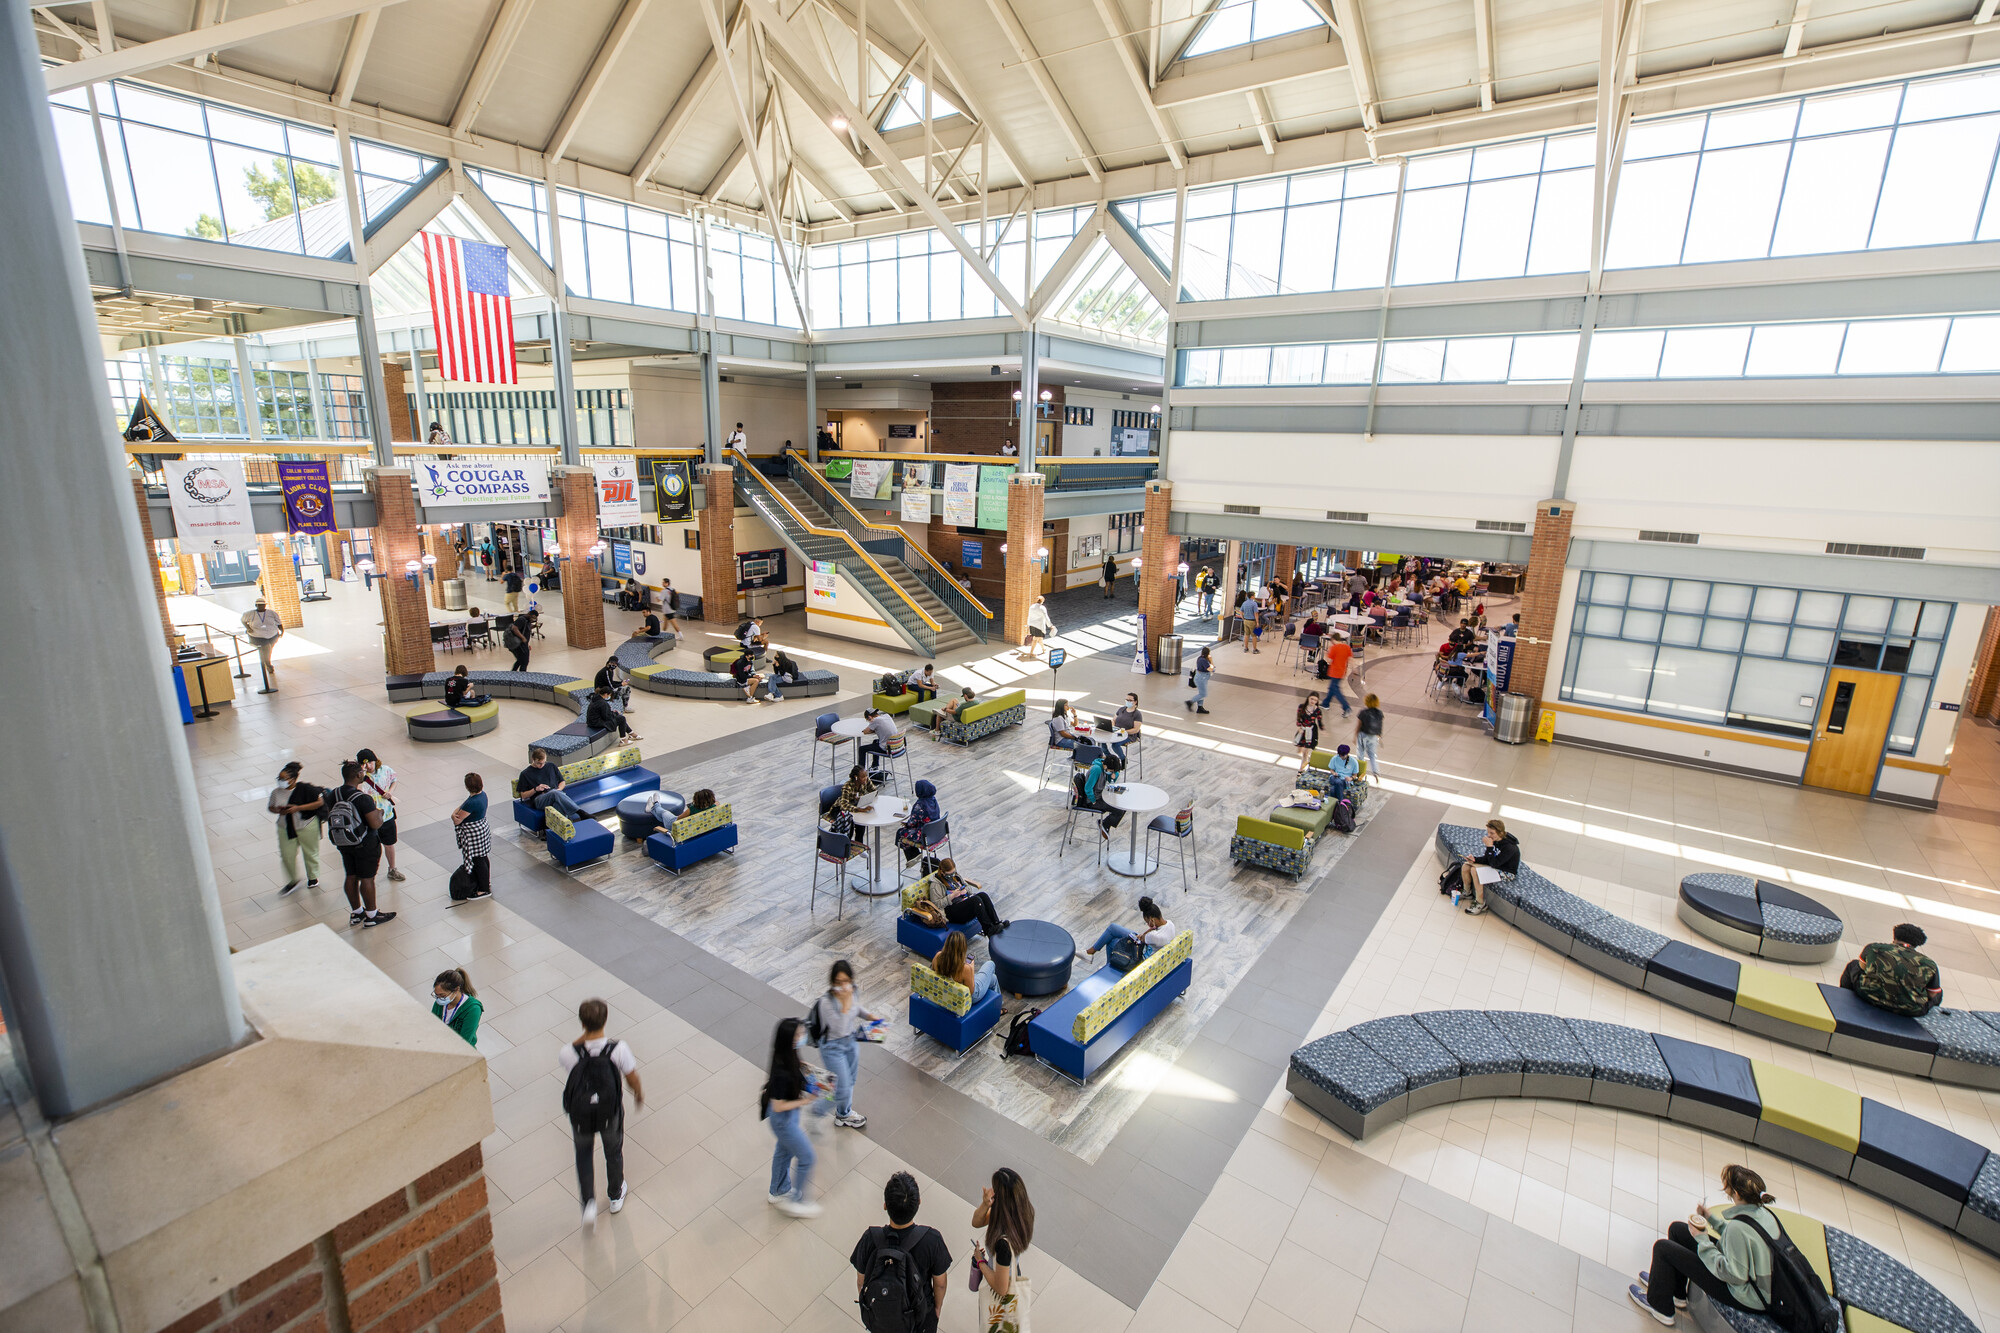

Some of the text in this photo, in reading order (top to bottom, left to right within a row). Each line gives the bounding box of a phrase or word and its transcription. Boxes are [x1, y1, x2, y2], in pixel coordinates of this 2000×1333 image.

[447, 470, 526, 482] COUGAR
[197, 480, 228, 488] MSA
[286, 484, 328, 494] LIONS CLUB
[455, 483, 530, 495] COMPASS
[306, 500, 314, 509] L
[1498, 645, 1509, 662] FIND
